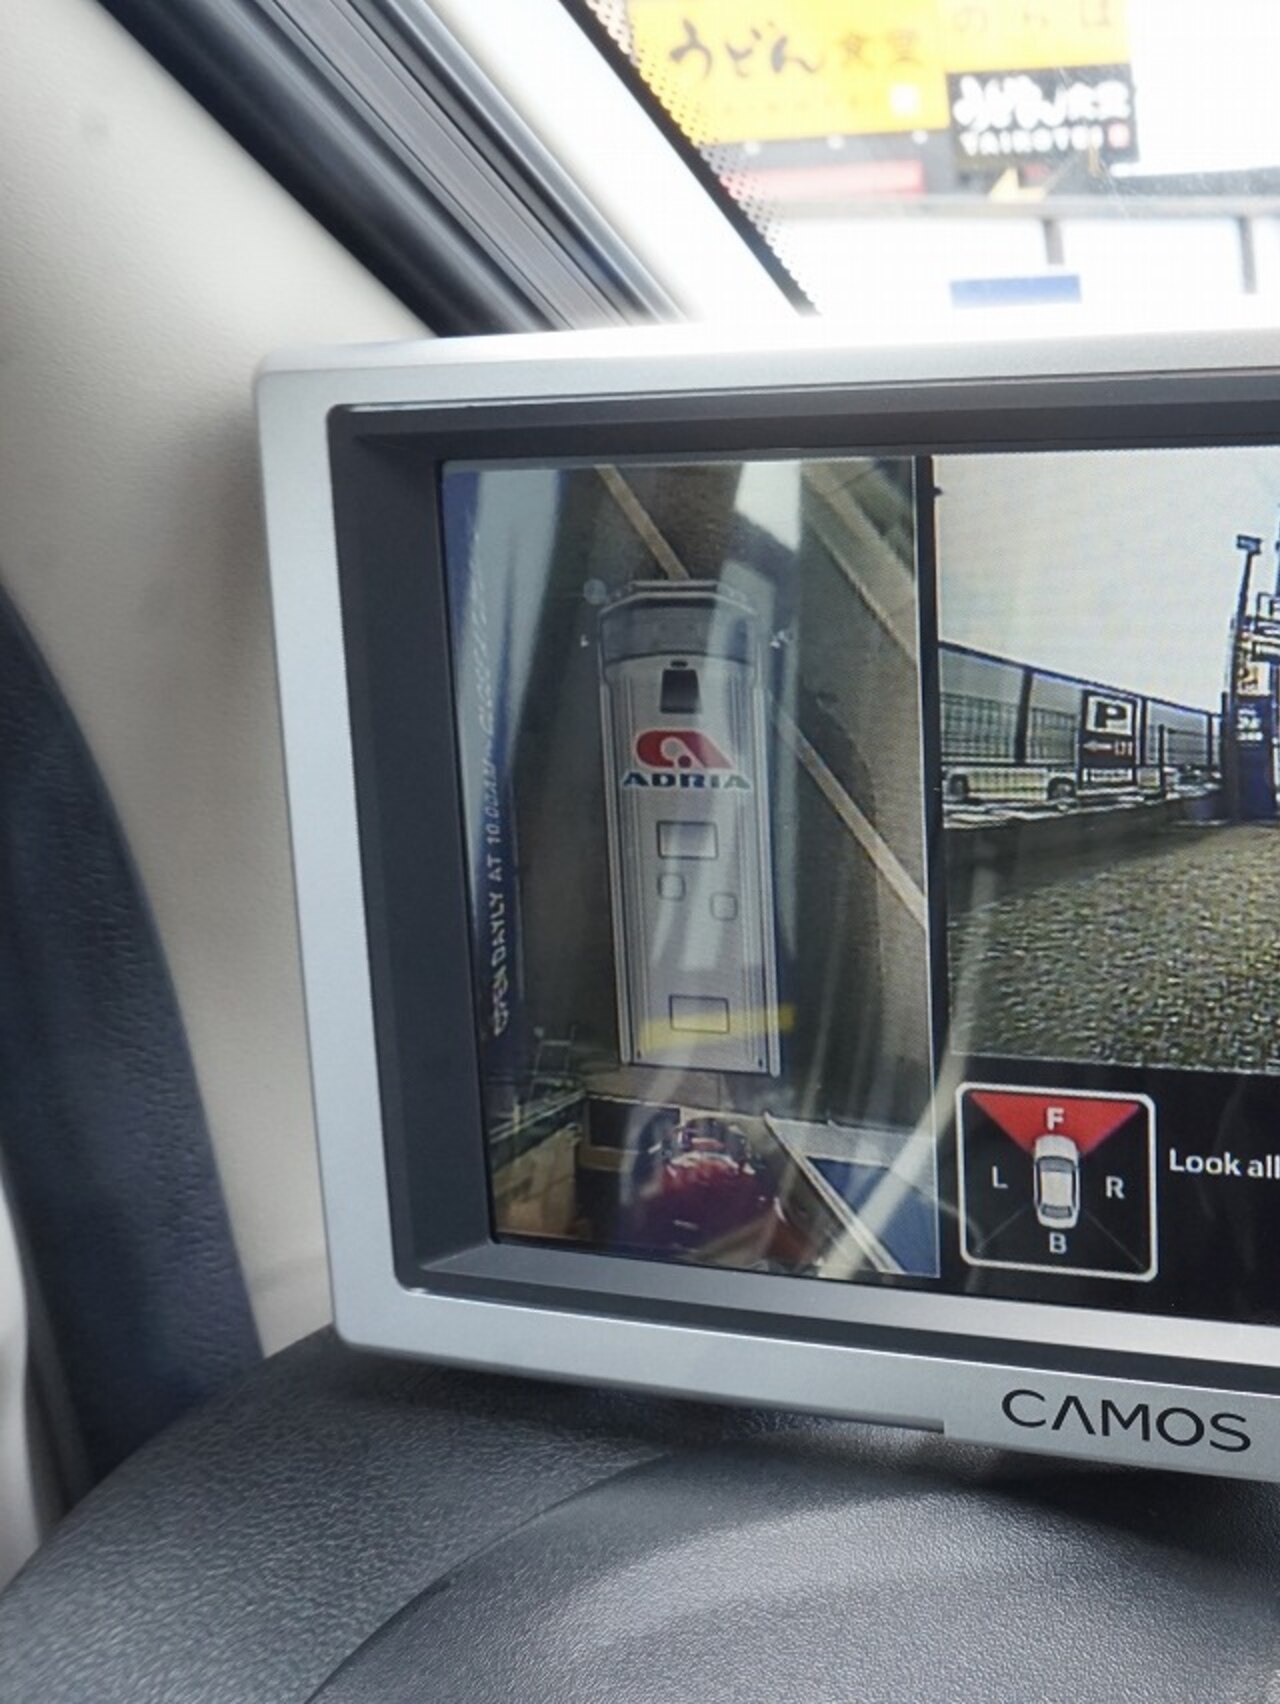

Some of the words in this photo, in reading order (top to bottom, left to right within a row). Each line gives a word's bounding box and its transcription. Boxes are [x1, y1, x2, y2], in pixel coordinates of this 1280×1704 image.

[1094, 701, 1127, 728] P
[622, 771, 751, 789] ADRIA
[485, 853, 504, 881] AT
[1046, 1107, 1065, 1130] F
[1168, 1148, 1242, 1177] Look
[1247, 1154, 1280, 1180] all
[992, 1165, 1008, 1190] L
[1105, 1176, 1126, 1200] R
[1048, 1232, 1068, 1255] B
[1001, 1388, 1252, 1453] CAMOS
